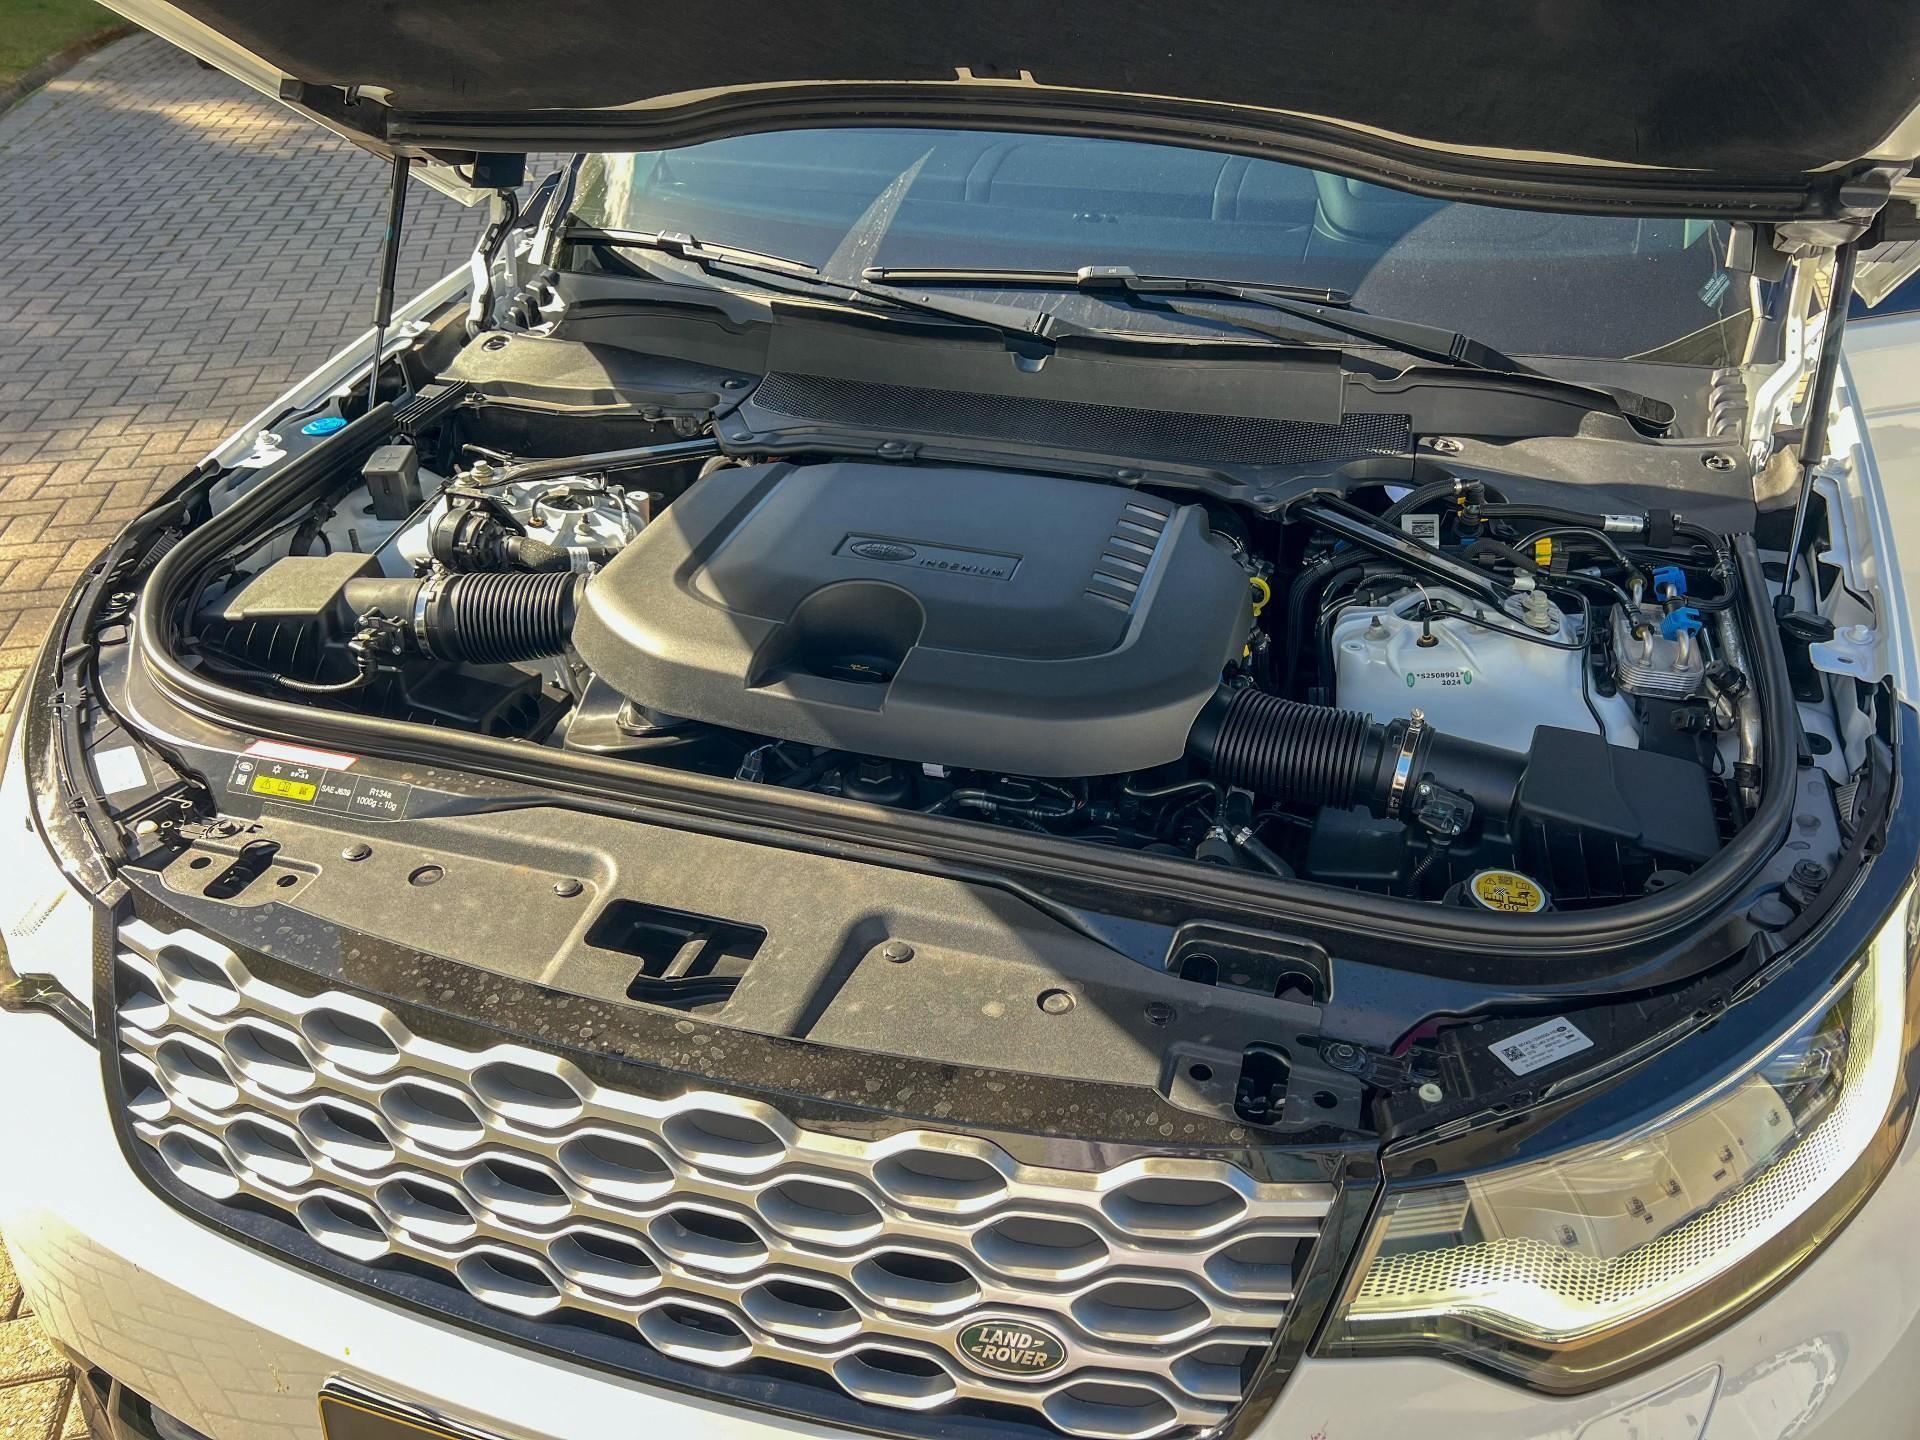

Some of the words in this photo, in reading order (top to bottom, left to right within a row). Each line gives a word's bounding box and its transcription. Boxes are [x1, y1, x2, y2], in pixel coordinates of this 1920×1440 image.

[919, 558, 1004, 577] INGENIUM
[321, 784, 335, 794] SAE
[369, 788, 392, 799] R134a
[356, 796, 378, 808] 1000g
[384, 801, 397, 811] 10g
[978, 1327, 1033, 1349] LAND
[982, 1345, 1048, 1367] ROVER
